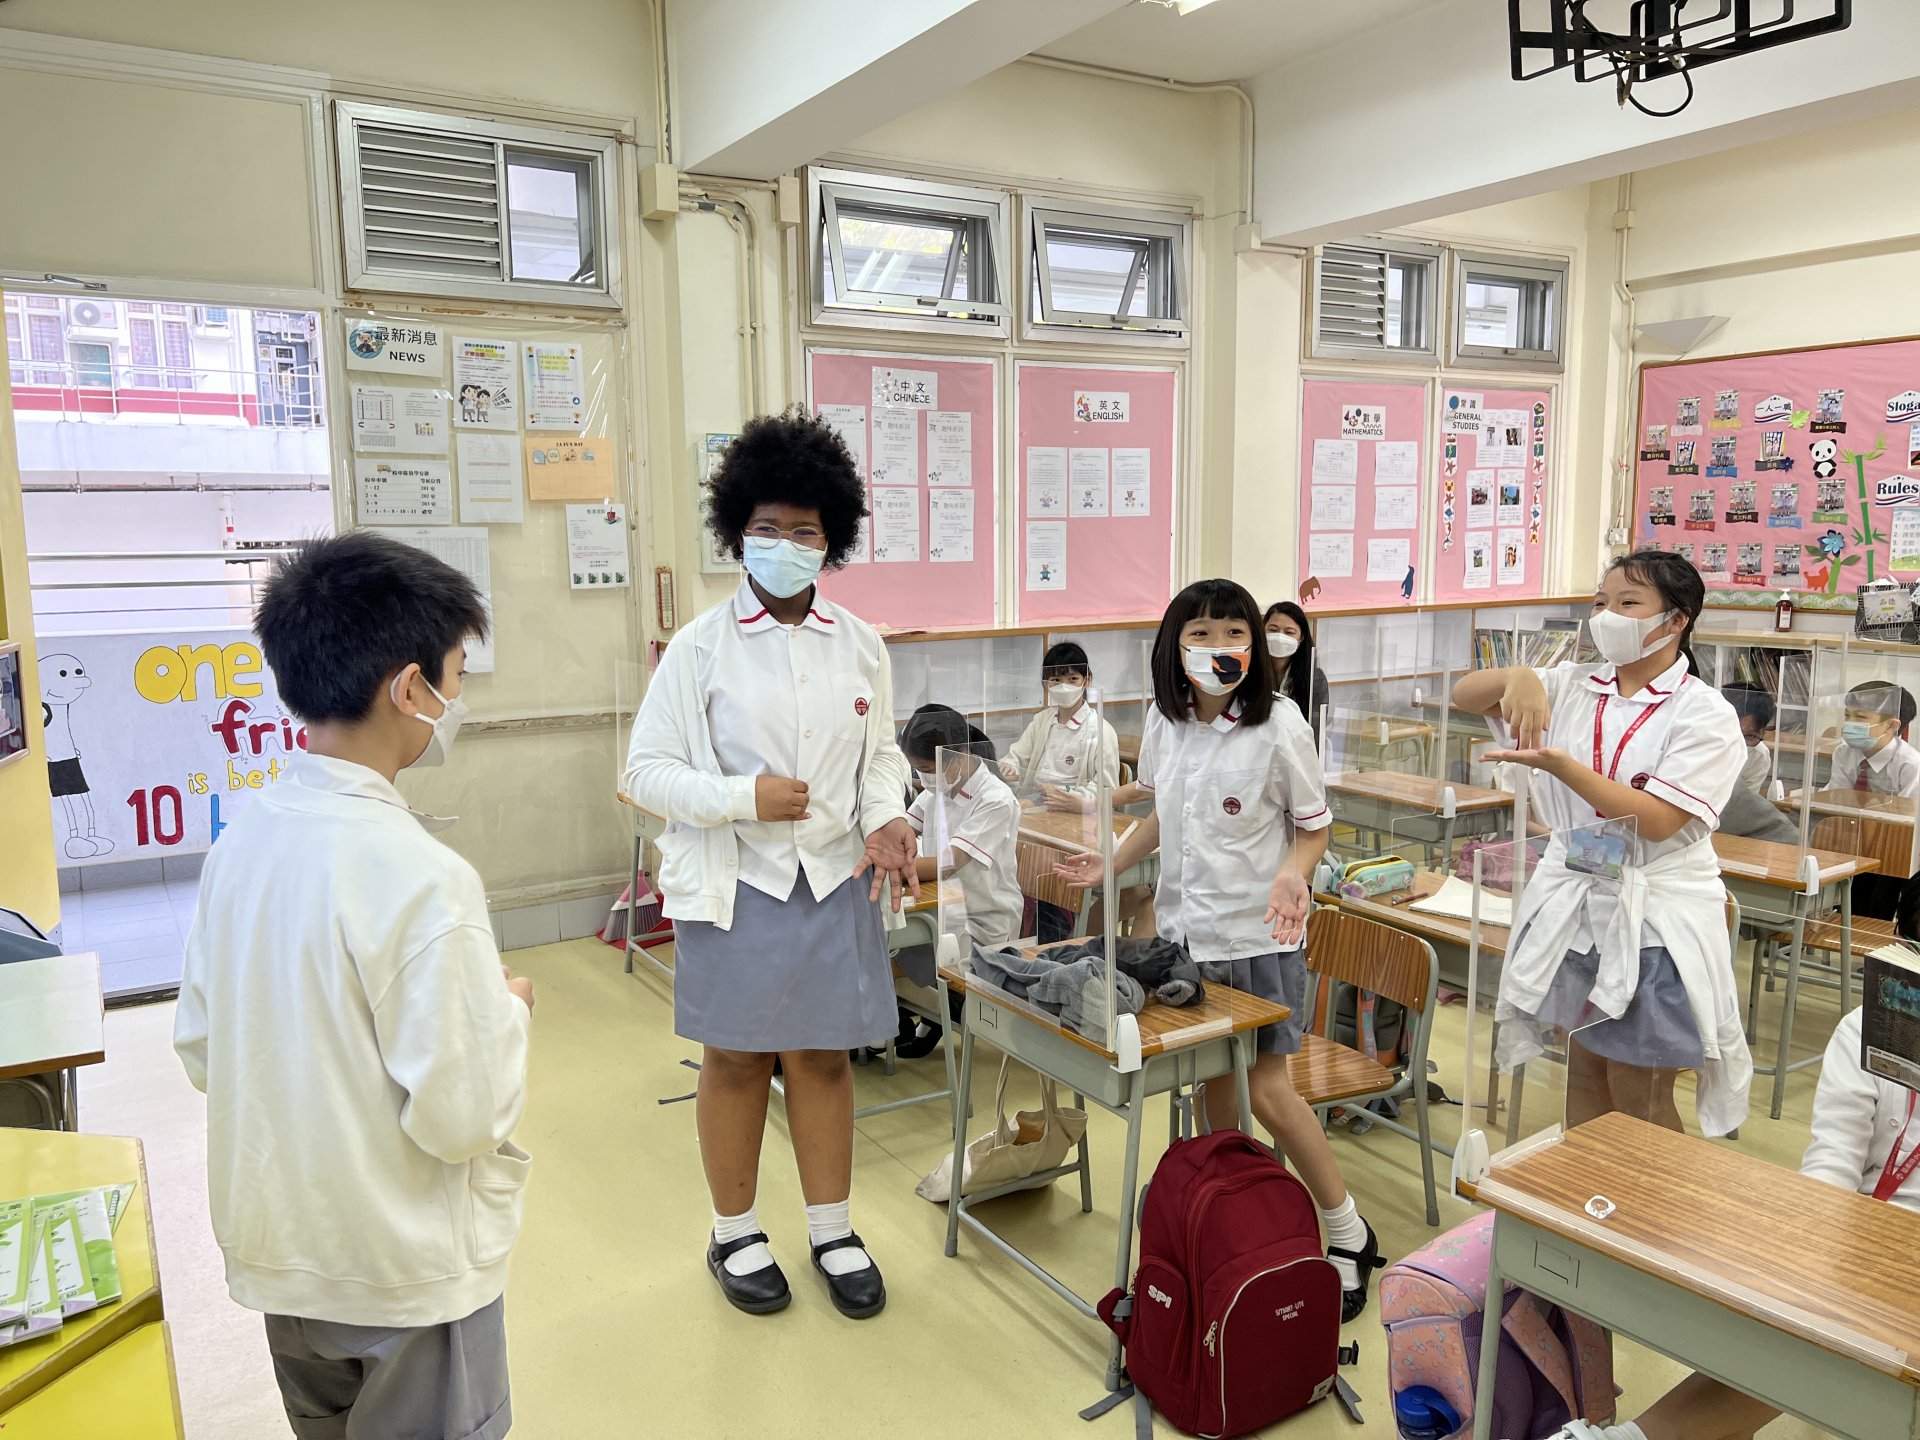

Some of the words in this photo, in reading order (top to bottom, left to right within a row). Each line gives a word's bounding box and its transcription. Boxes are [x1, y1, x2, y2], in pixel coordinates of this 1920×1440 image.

[377, 326, 437, 346] 最新消息
[389, 351, 425, 363] NEWS
[901, 380, 925, 393] 中文
[1099, 400, 1120, 411] 英文
[1756, 403, 1792, 412] 一人一職
[1093, 411, 1123, 420] ENGLISH
[1363, 413, 1380, 423] 數學
[1454, 412, 1482, 421] GENERAL
[1452, 421, 1479, 430] STUDIES
[1343, 428, 1383, 436] MATHEMATICS
[1877, 482, 1919, 495] Rules
[134, 642, 263, 704] one
[188, 772, 209, 794] is
[227, 758, 289, 790] bet
[127, 784, 184, 846] 10
